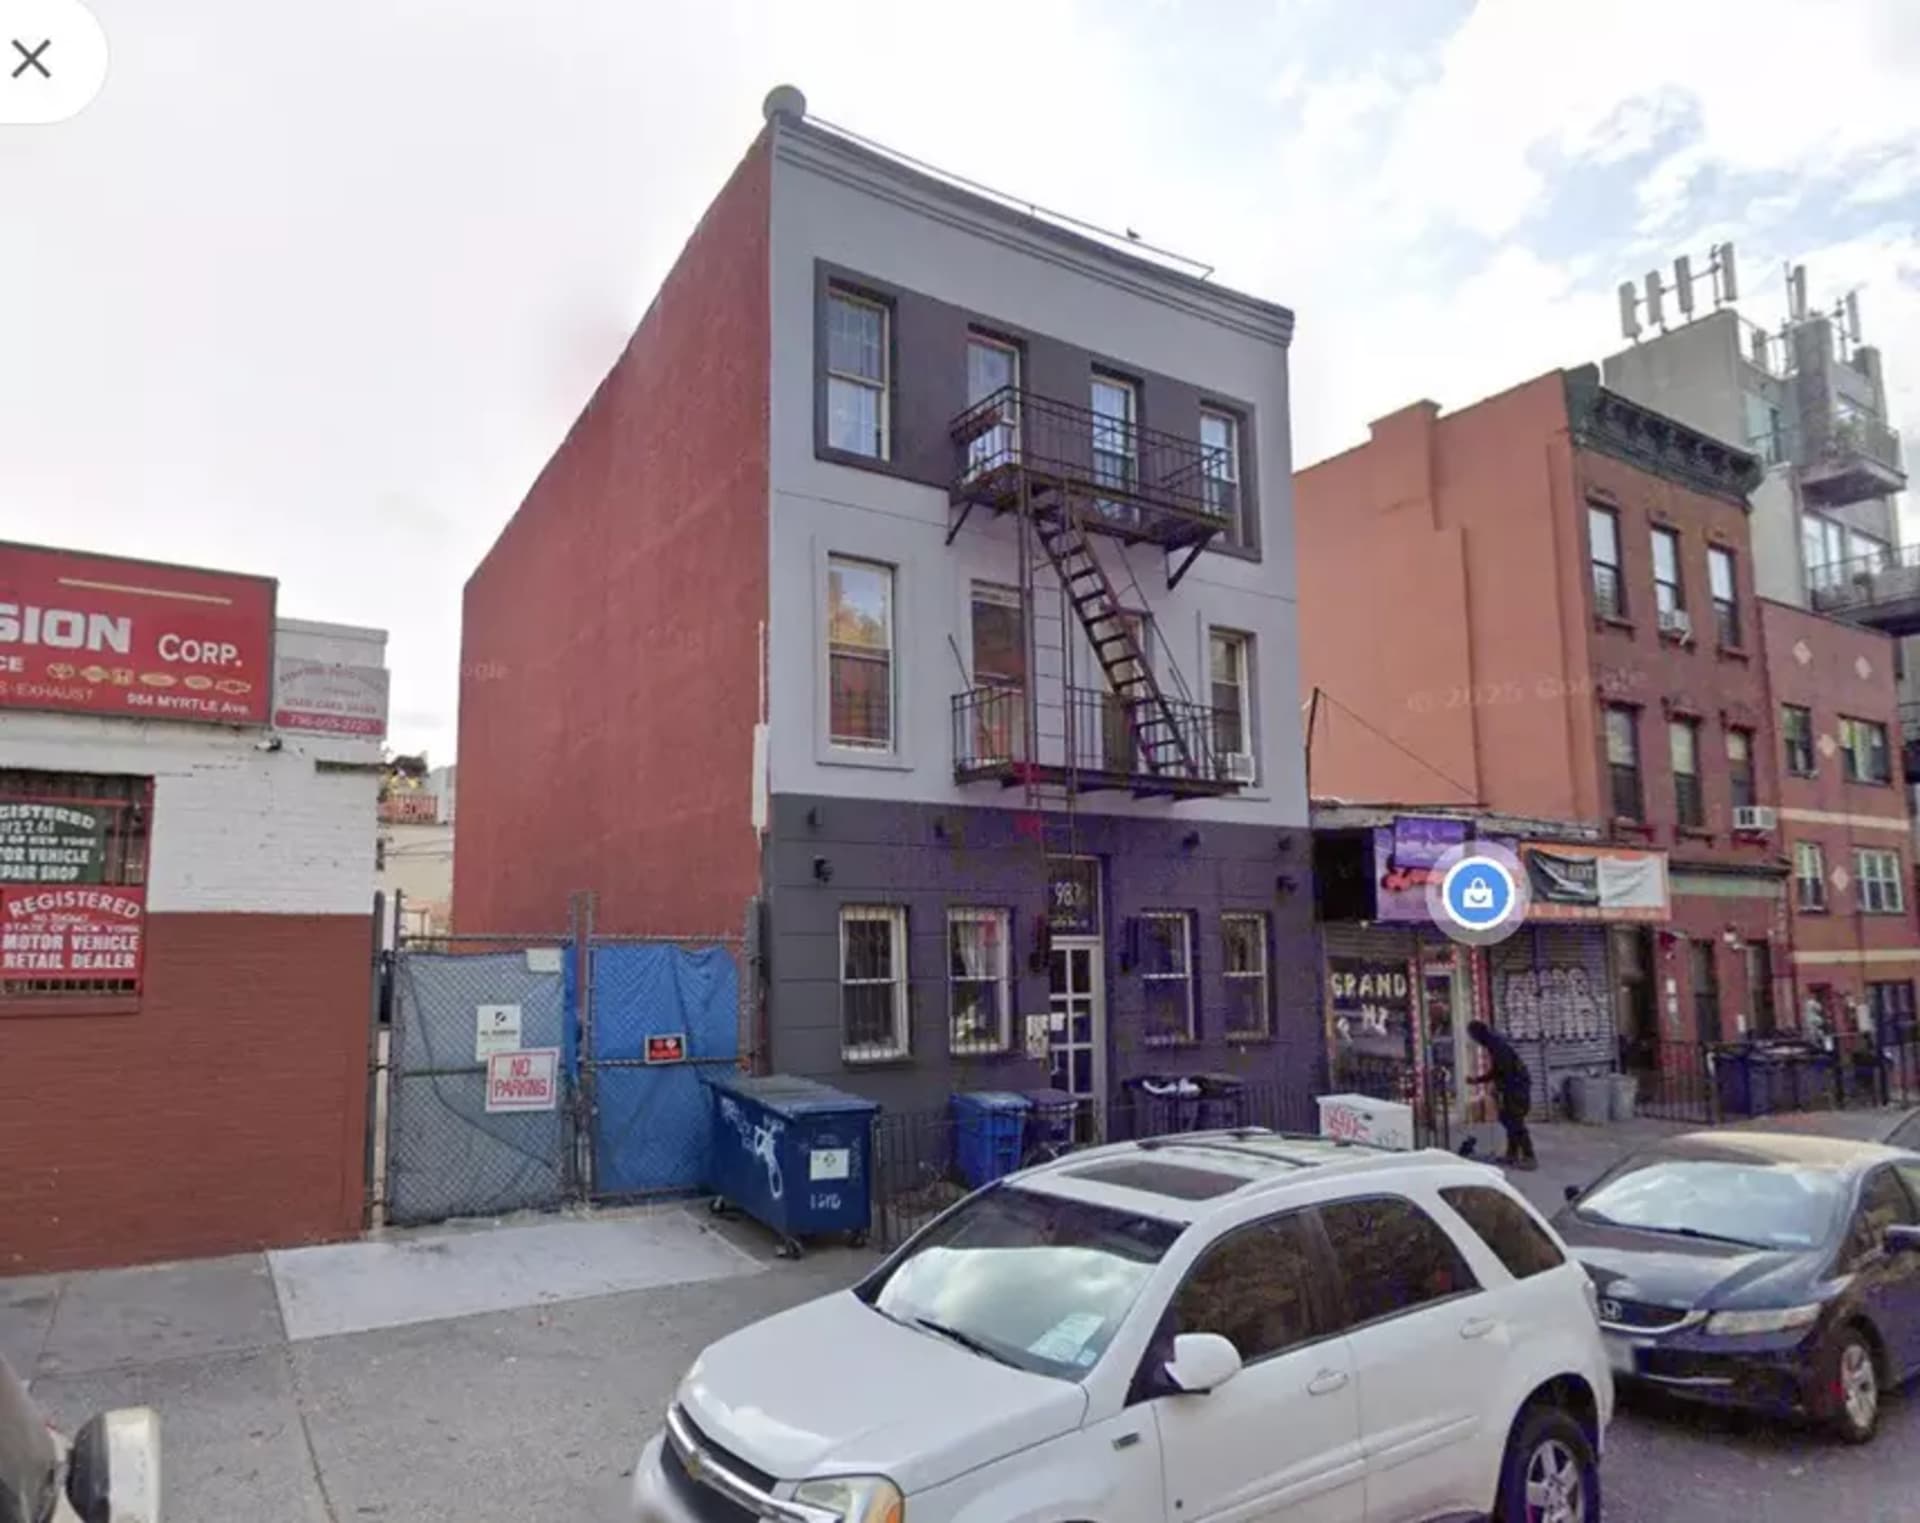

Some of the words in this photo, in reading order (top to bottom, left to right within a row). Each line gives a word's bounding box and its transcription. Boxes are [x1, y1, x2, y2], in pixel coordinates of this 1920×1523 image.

[158, 633, 243, 667] CORP.
[157, 695, 218, 713] MYRTLE
[28, 847, 90, 864] VEHICLE
[8, 890, 140, 919] REGISTERED
[3, 933, 64, 950] MOTOR
[71, 934, 140, 951] VEHICLE
[3, 951, 64, 969] RETAIL
[71, 952, 136, 969] DEALER
[510, 1055, 531, 1077] NO
[494, 1078, 548, 1097] PARKING
